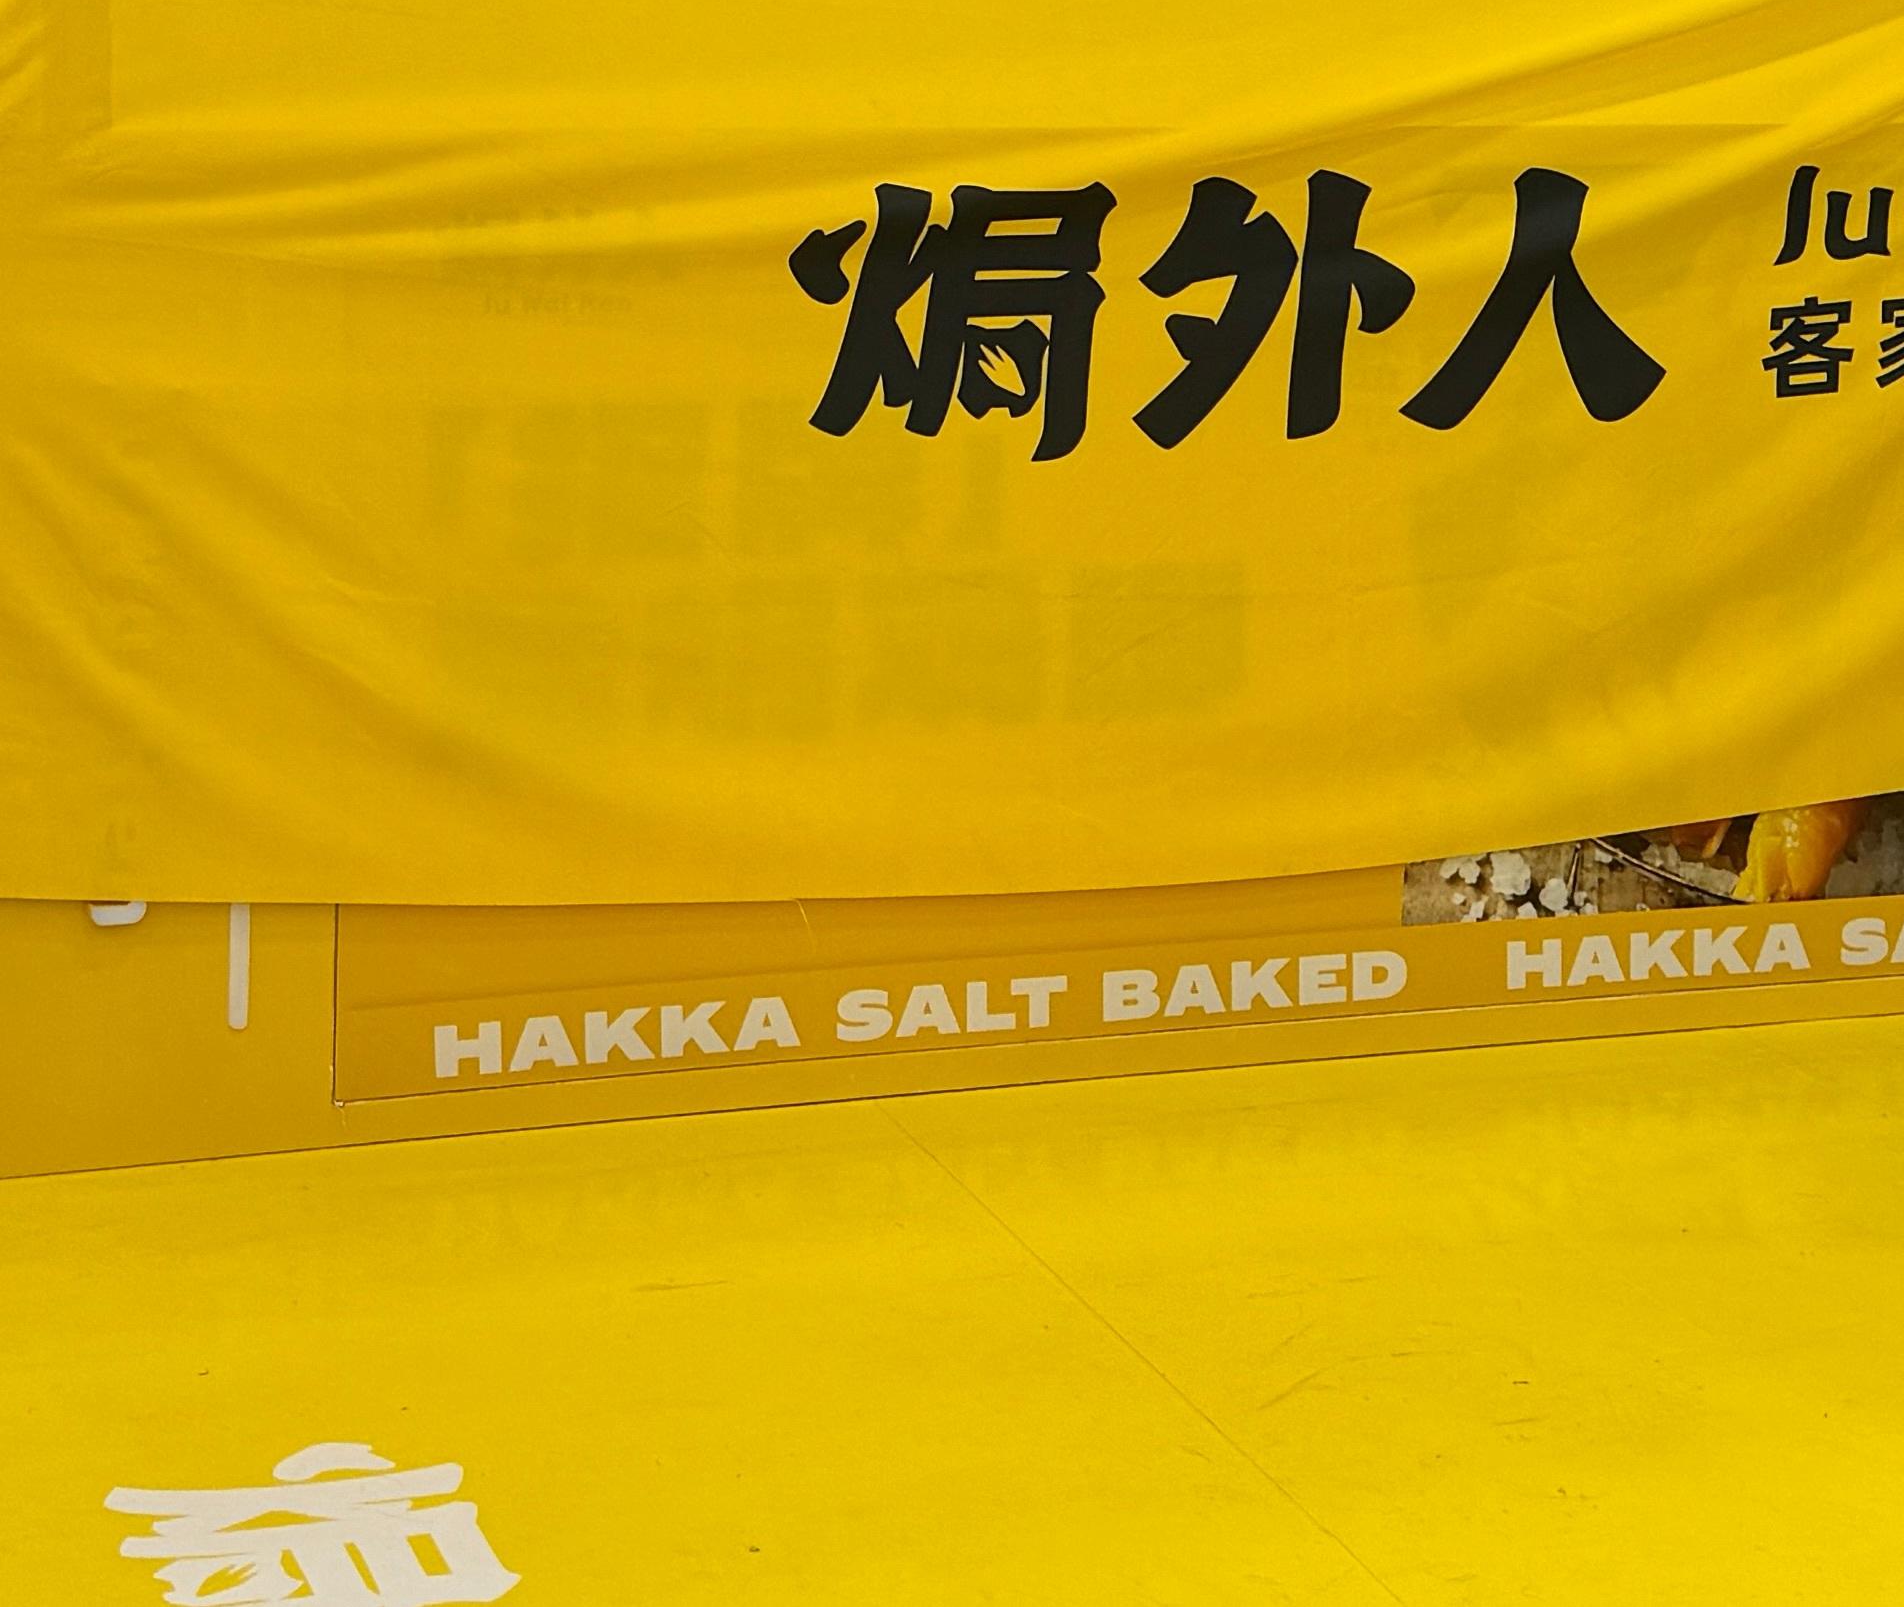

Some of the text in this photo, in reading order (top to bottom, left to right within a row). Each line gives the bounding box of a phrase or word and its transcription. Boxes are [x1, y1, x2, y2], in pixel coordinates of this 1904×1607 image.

[1775, 165, 1894, 266] Ju
[787, 166, 1667, 463] 焗外人
[434, 950, 1407, 1079] HAKKA SALT BAKED
[1506, 923, 1811, 991] HAKKA
